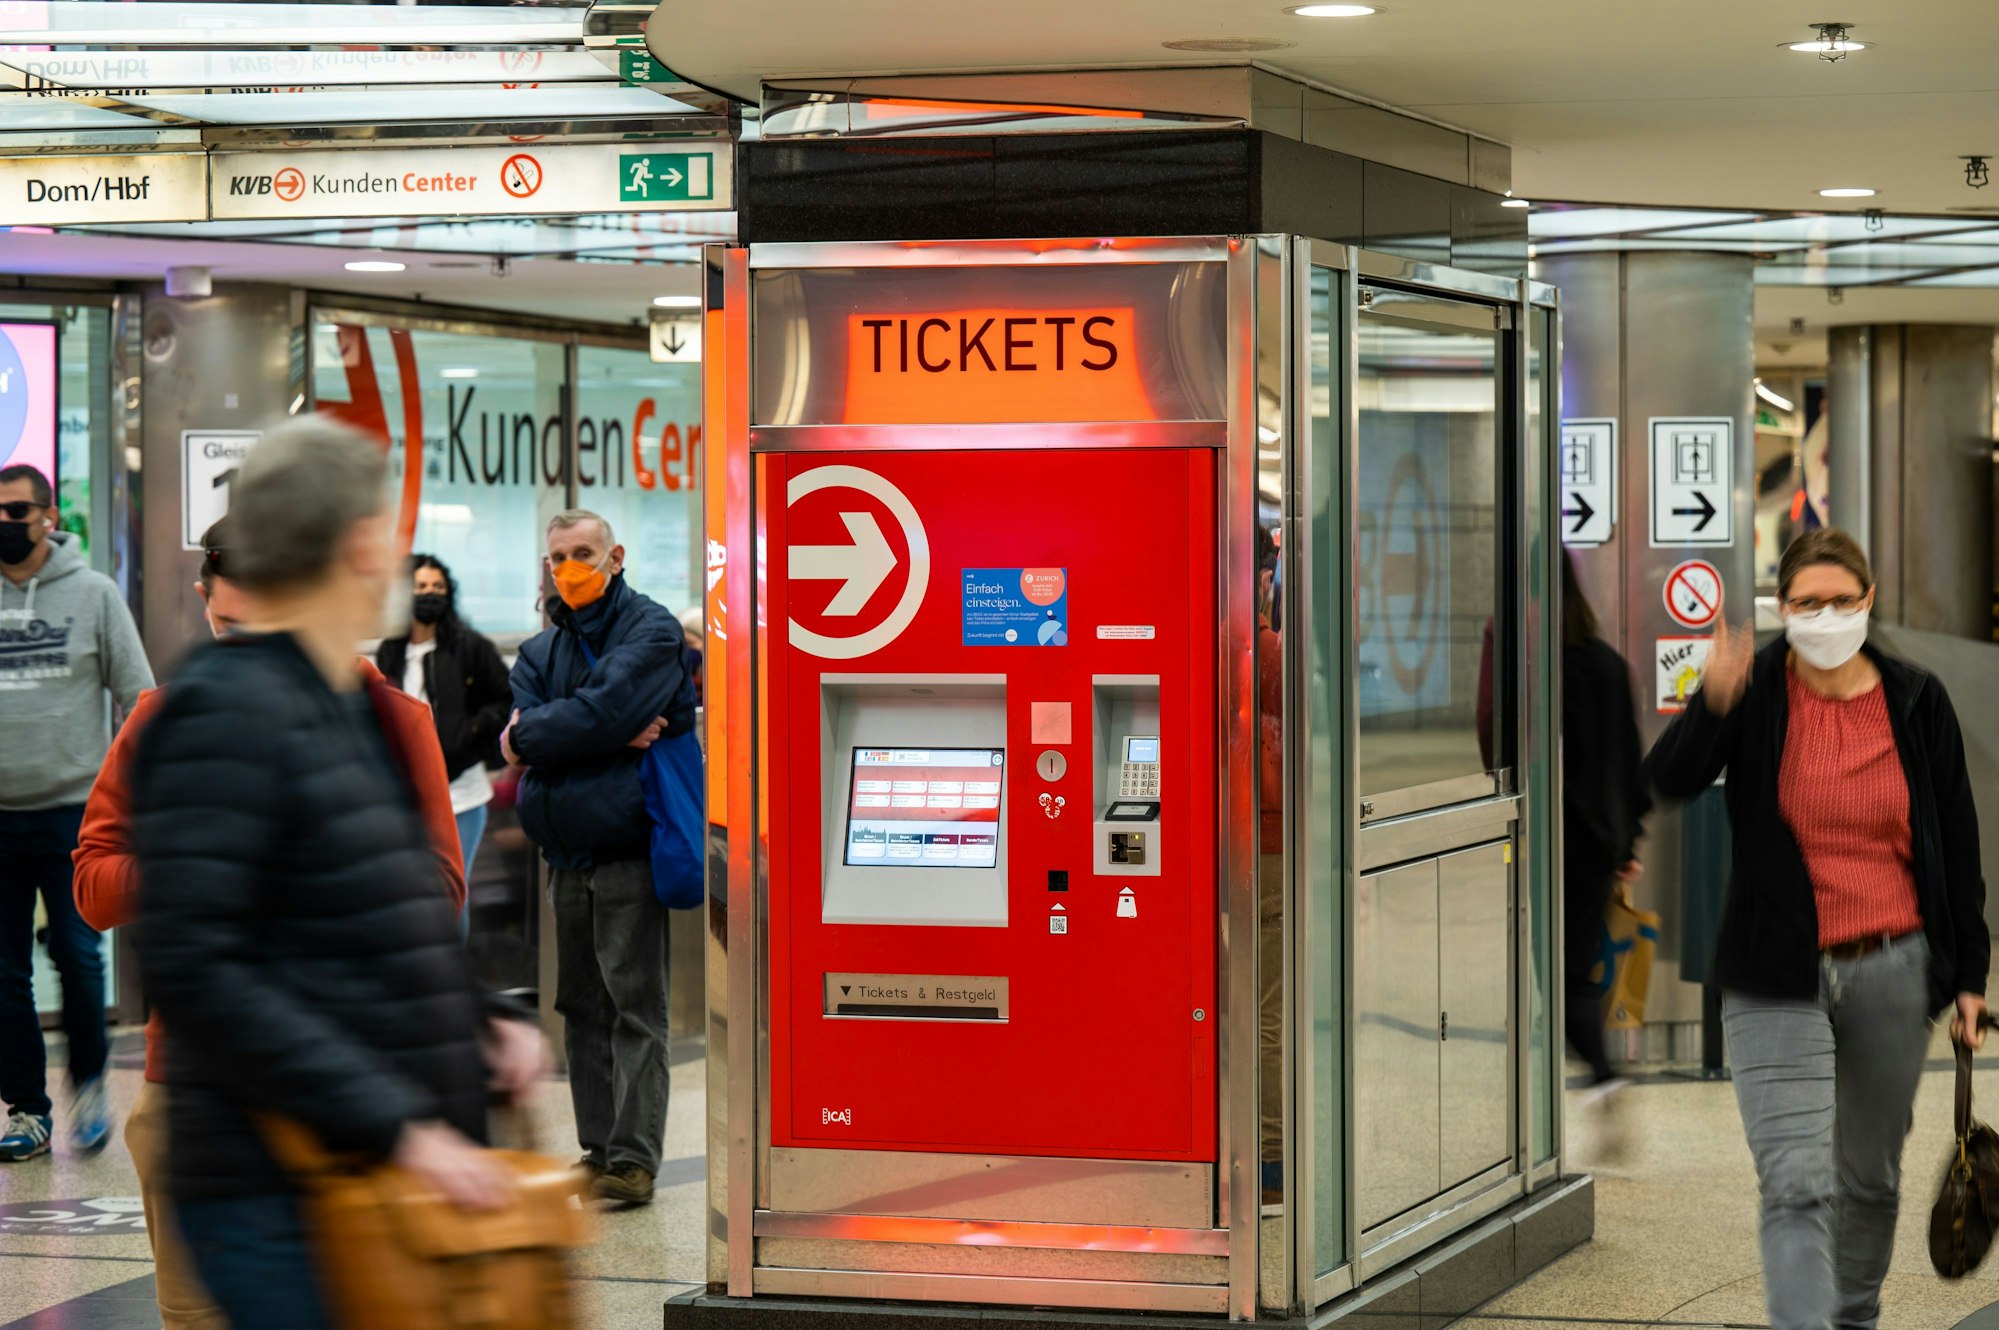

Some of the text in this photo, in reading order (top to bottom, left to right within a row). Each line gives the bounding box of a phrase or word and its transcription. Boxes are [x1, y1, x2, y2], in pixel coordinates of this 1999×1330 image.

[27, 176, 150, 202] Dom/Hbf
[230, 176, 272, 195] KVB
[862, 316, 1118, 373] TICKETS
[1035, 575, 1059, 583] ZURICH
[966, 583, 1004, 594] Einfach
[966, 597, 1021, 611] einsteigen.
[1660, 643, 1694, 671] Hier
[859, 986, 996, 1003] Tickets & Restgeld
